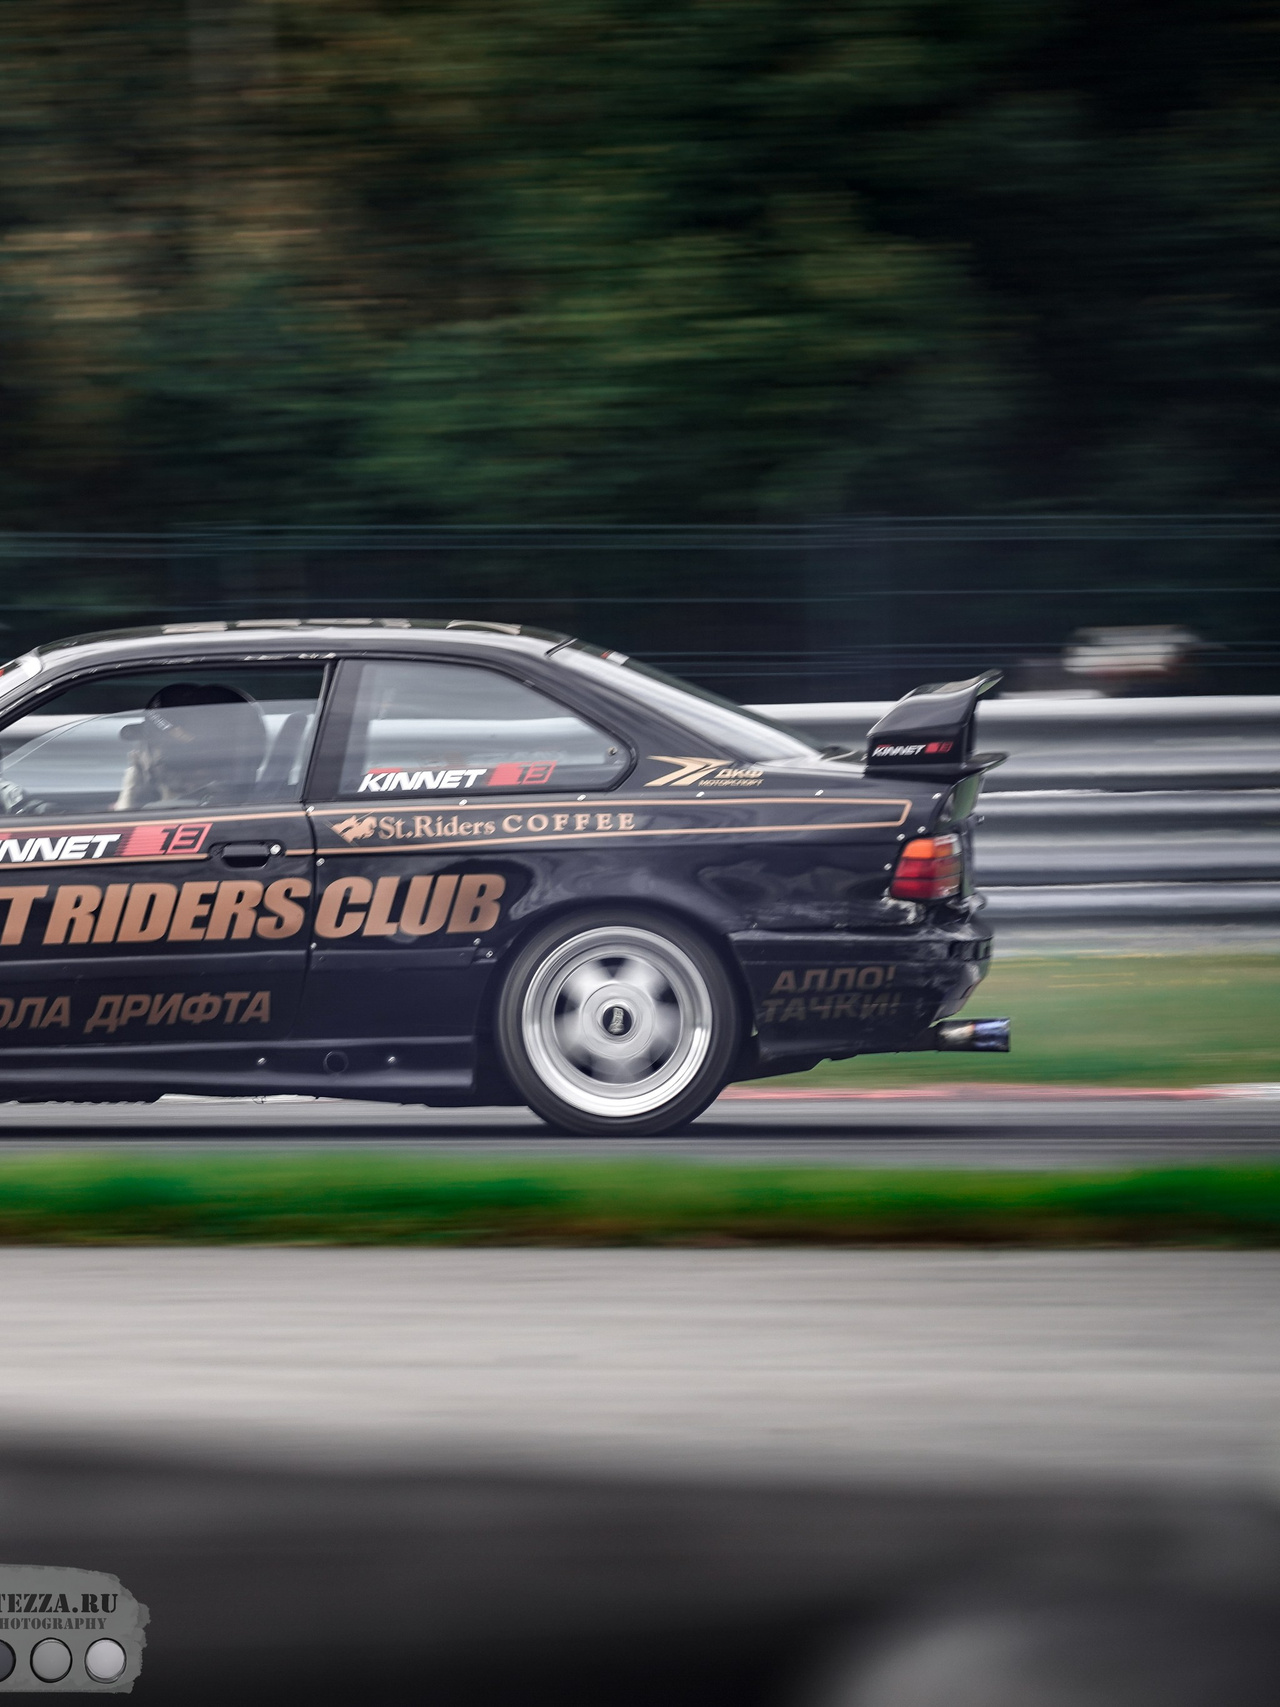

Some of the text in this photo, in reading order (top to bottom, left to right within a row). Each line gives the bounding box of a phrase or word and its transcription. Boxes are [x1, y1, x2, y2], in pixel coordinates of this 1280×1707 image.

[872, 744, 926, 757] KINNET
[357, 768, 487, 793] KINNET
[502, 812, 636, 833] COFFEE
[42, 877, 313, 945] RIDERS
[314, 873, 506, 939] CLUB
[771, 965, 896, 994] АЛЛО!
[83, 991, 271, 1034] ДРИФТА
[761, 993, 903, 1023] ТАЧКИ!
